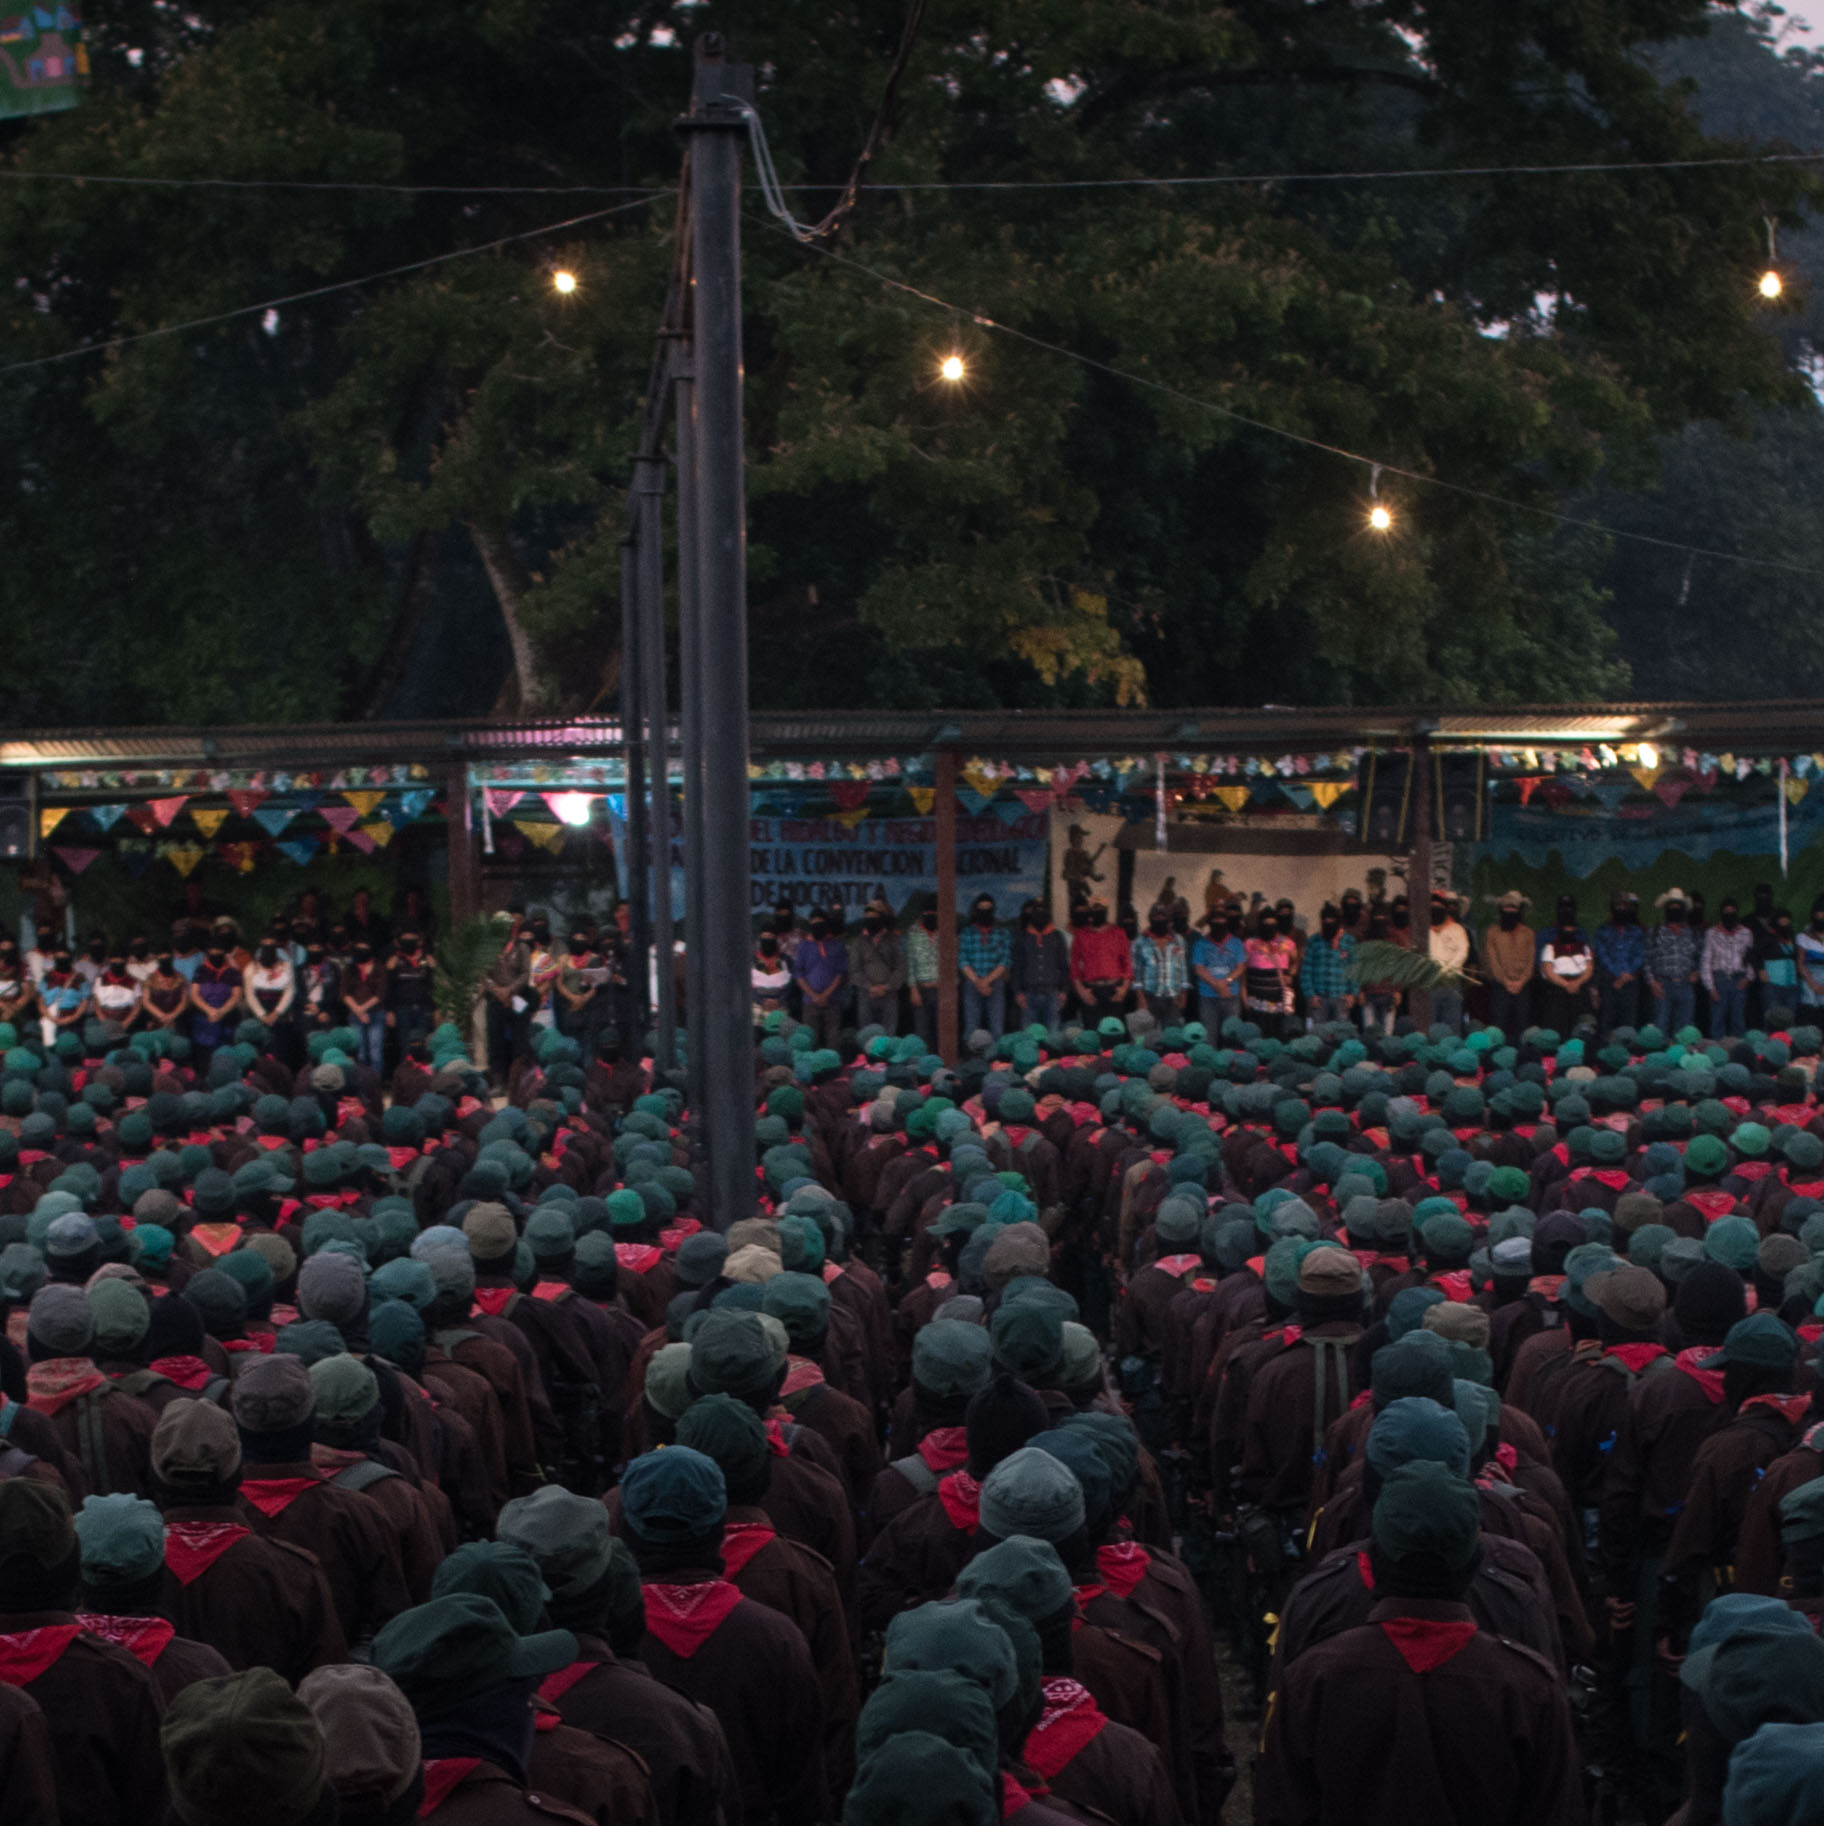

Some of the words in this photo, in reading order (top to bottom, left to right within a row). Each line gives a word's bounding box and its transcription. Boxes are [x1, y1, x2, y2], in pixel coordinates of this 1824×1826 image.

[774, 849, 796, 874] LA
[803, 849, 924, 875] CONVENCION
[934, 847, 1021, 875] CIONAL
